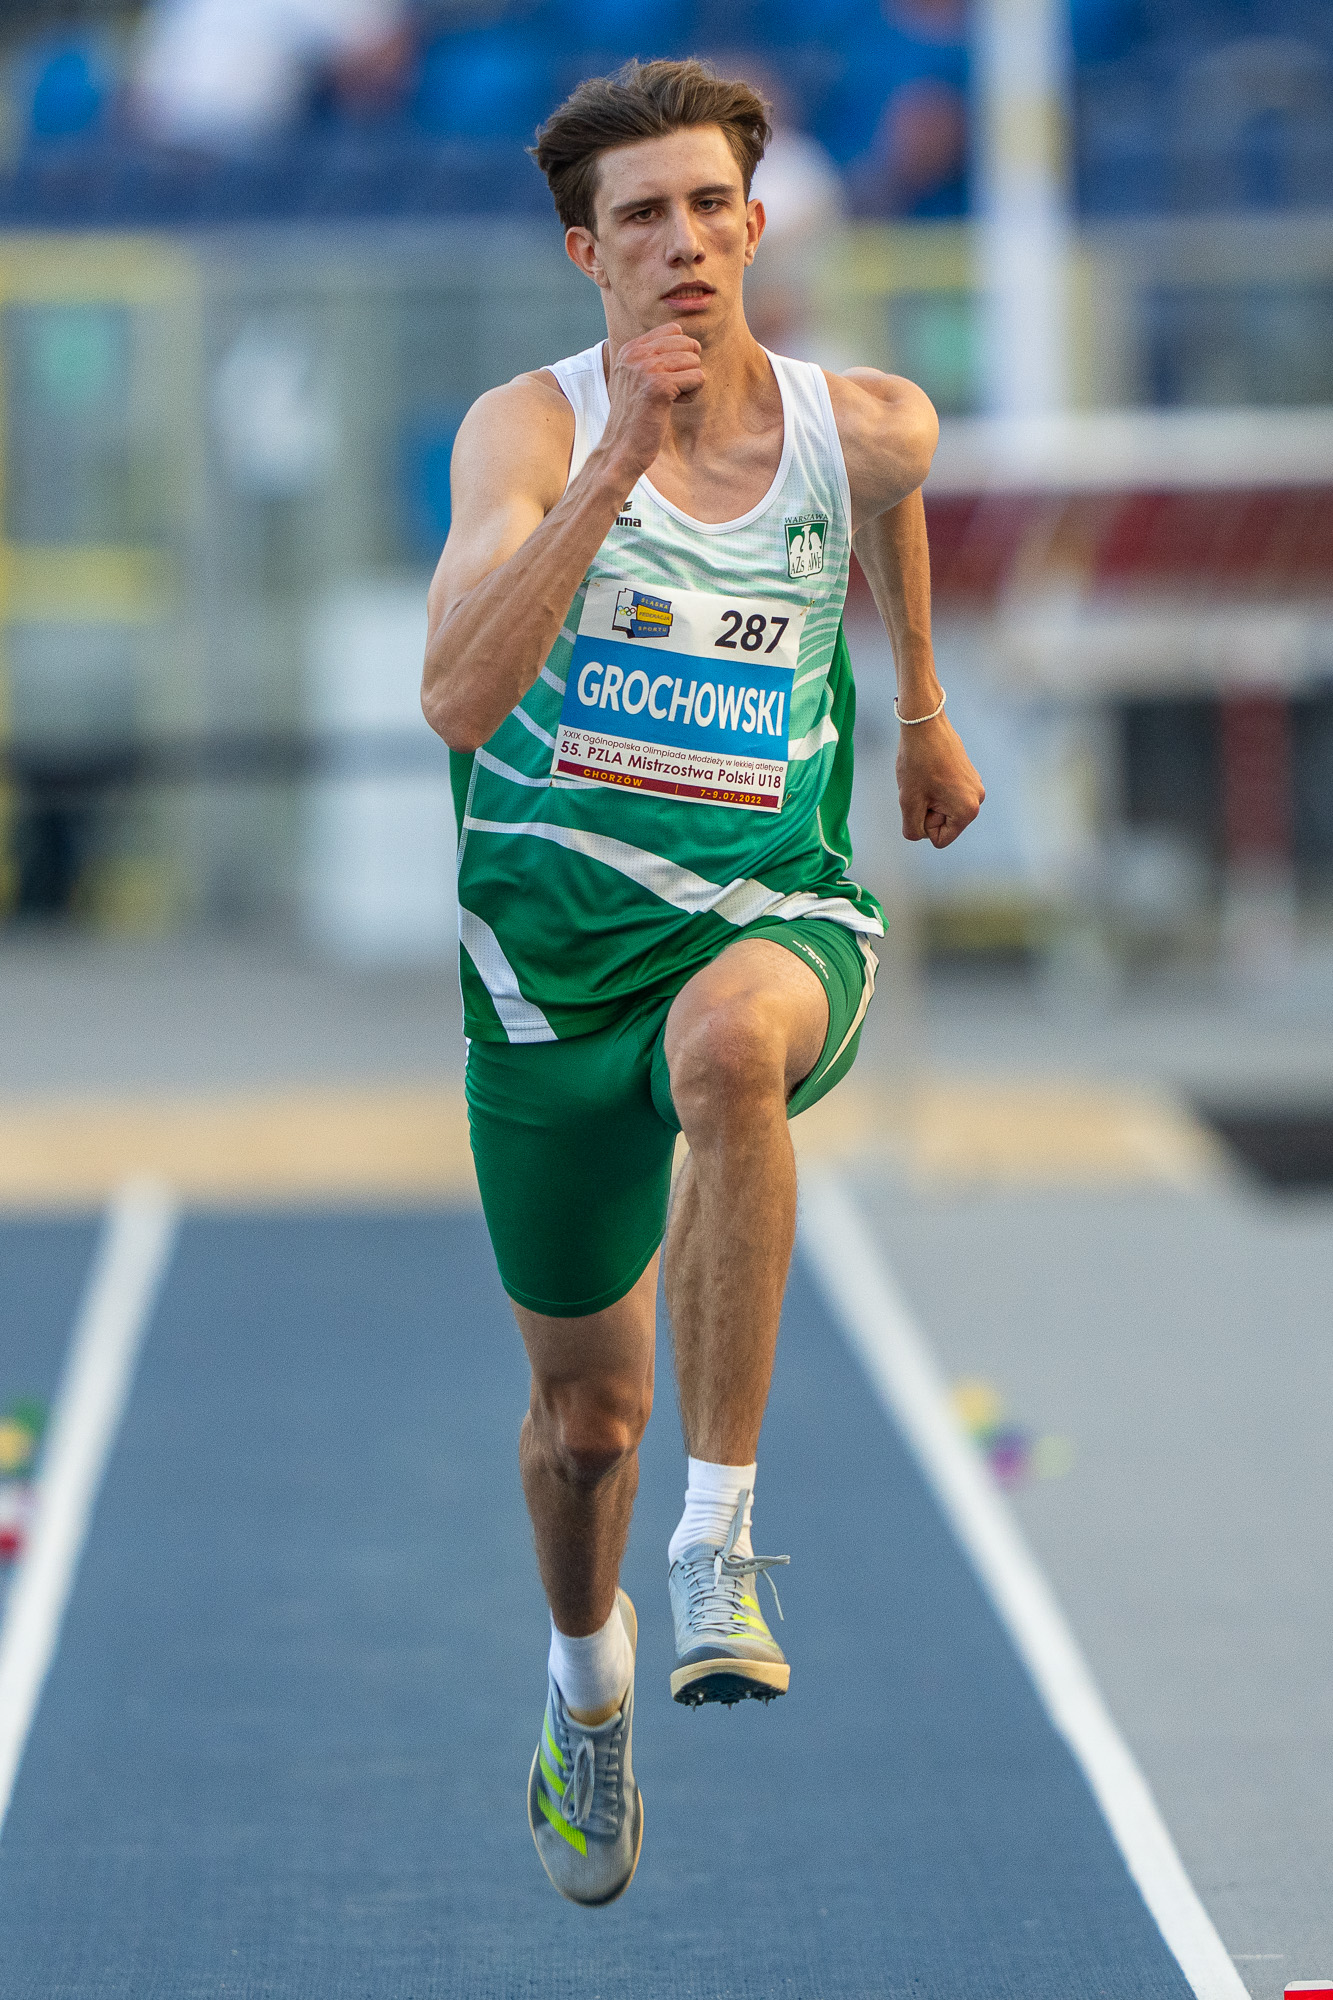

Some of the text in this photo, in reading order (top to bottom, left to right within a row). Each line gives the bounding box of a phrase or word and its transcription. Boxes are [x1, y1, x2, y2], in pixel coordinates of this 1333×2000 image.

[784, 513, 829, 523] WARSZAWA
[790, 556, 805, 574] AZS
[639, 612, 670, 621] FEDERACJA
[714, 609, 790, 654] 287
[577, 661, 786, 737] GROCHOWSKI
[560, 740, 781, 789] 55. PZLA Mistrzostwa Polski U18
[563, 729, 581, 740] XXIX
[583, 734, 640, 752] Ogólnopolska
[643, 745, 686, 760] Olimpiada
[688, 754, 724, 766] Młodzieży
[733, 760, 754, 771] lekkiej
[755, 763, 784, 773] atletyce
[583, 768, 762, 804] CHORZÓW 7-9.07.2022
